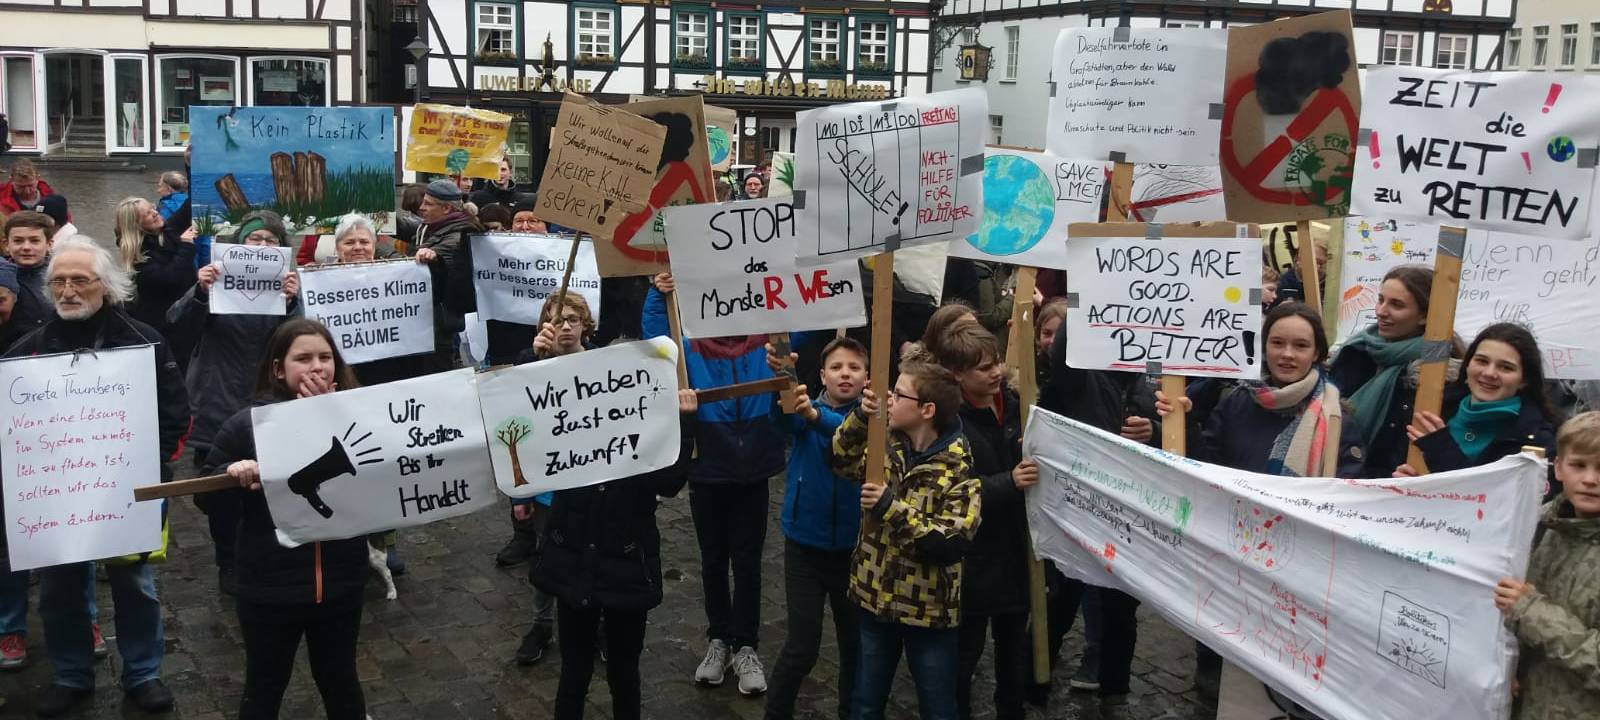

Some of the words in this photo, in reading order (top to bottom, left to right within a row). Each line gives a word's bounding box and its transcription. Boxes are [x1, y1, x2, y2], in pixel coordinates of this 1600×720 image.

[1157, 39, 1168, 52] in
[550, 78, 592, 93] RAABE
[743, 80, 820, 98] wilden
[826, 79, 886, 99] Mann
[1389, 77, 1498, 109] ZEIT
[251, 115, 289, 138] Kein
[569, 112, 586, 129] Wir
[636, 144, 650, 155] die
[822, 124, 838, 138] MO
[900, 114, 916, 127] DO
[921, 107, 956, 123] FREITAG
[1153, 125, 1173, 135] nicht
[1485, 112, 1527, 138] die
[1324, 134, 1349, 151] FOR
[922, 150, 955, 166] NACH-
[1396, 134, 1507, 176] WELT
[551, 148, 596, 188] keine
[597, 165, 633, 202] Kohle
[921, 169, 953, 186] HILFE
[1057, 162, 1099, 183] SAVE
[543, 184, 615, 225] sehen!
[925, 185, 951, 200] FÜR
[1374, 187, 1402, 204] zu
[1422, 181, 1579, 228] RETTEN
[918, 201, 974, 225] POLITIKER
[230, 250, 254, 262] Mehr
[256, 251, 278, 262] Herz
[1463, 230, 1553, 265] Wenn
[245, 264, 259, 274] für
[498, 258, 531, 271] Mehr
[744, 257, 768, 273] das
[1096, 246, 1180, 277] WORDS
[1190, 249, 1241, 279] ARE
[1461, 259, 1511, 283] eiter
[224, 274, 282, 292] Bäume
[477, 270, 496, 281] für
[500, 272, 558, 288] besseres
[1129, 280, 1195, 302] GOOD.
[306, 289, 380, 306] Besseres
[384, 279, 427, 298] Klima
[512, 287, 524, 298] in
[701, 275, 788, 319] MonsteR
[794, 269, 853, 305] WEsen
[316, 311, 377, 328] braucht
[381, 302, 420, 321] mehr
[1087, 304, 1185, 327] ACTIONS
[1200, 308, 1248, 330] ARE
[1494, 300, 1531, 323] WIR
[341, 326, 400, 349] BÄUME
[1110, 328, 1256, 366] BETTER!
[9, 376, 57, 404] Greta
[61, 373, 131, 396] Thunberg:
[525, 380, 568, 412] Wir
[573, 369, 650, 401] haben
[50, 411, 75, 424] eine
[80, 407, 126, 425] Lösung
[388, 398, 426, 424] Wir
[551, 407, 604, 437] Lust
[608, 395, 648, 421] auf
[16, 440, 32, 454] im
[39, 433, 84, 452] System
[406, 424, 464, 448] Streiken
[17, 462, 36, 477] lich
[61, 458, 97, 475] finden
[104, 452, 131, 467] ist,
[397, 455, 421, 476] Bis
[427, 454, 445, 469] ihr
[545, 433, 641, 477] Zukunft!
[18, 487, 61, 502] sollten
[68, 480, 88, 493] wir
[93, 478, 117, 489] das
[398, 479, 471, 518] Handelt
[17, 517, 60, 539] System
